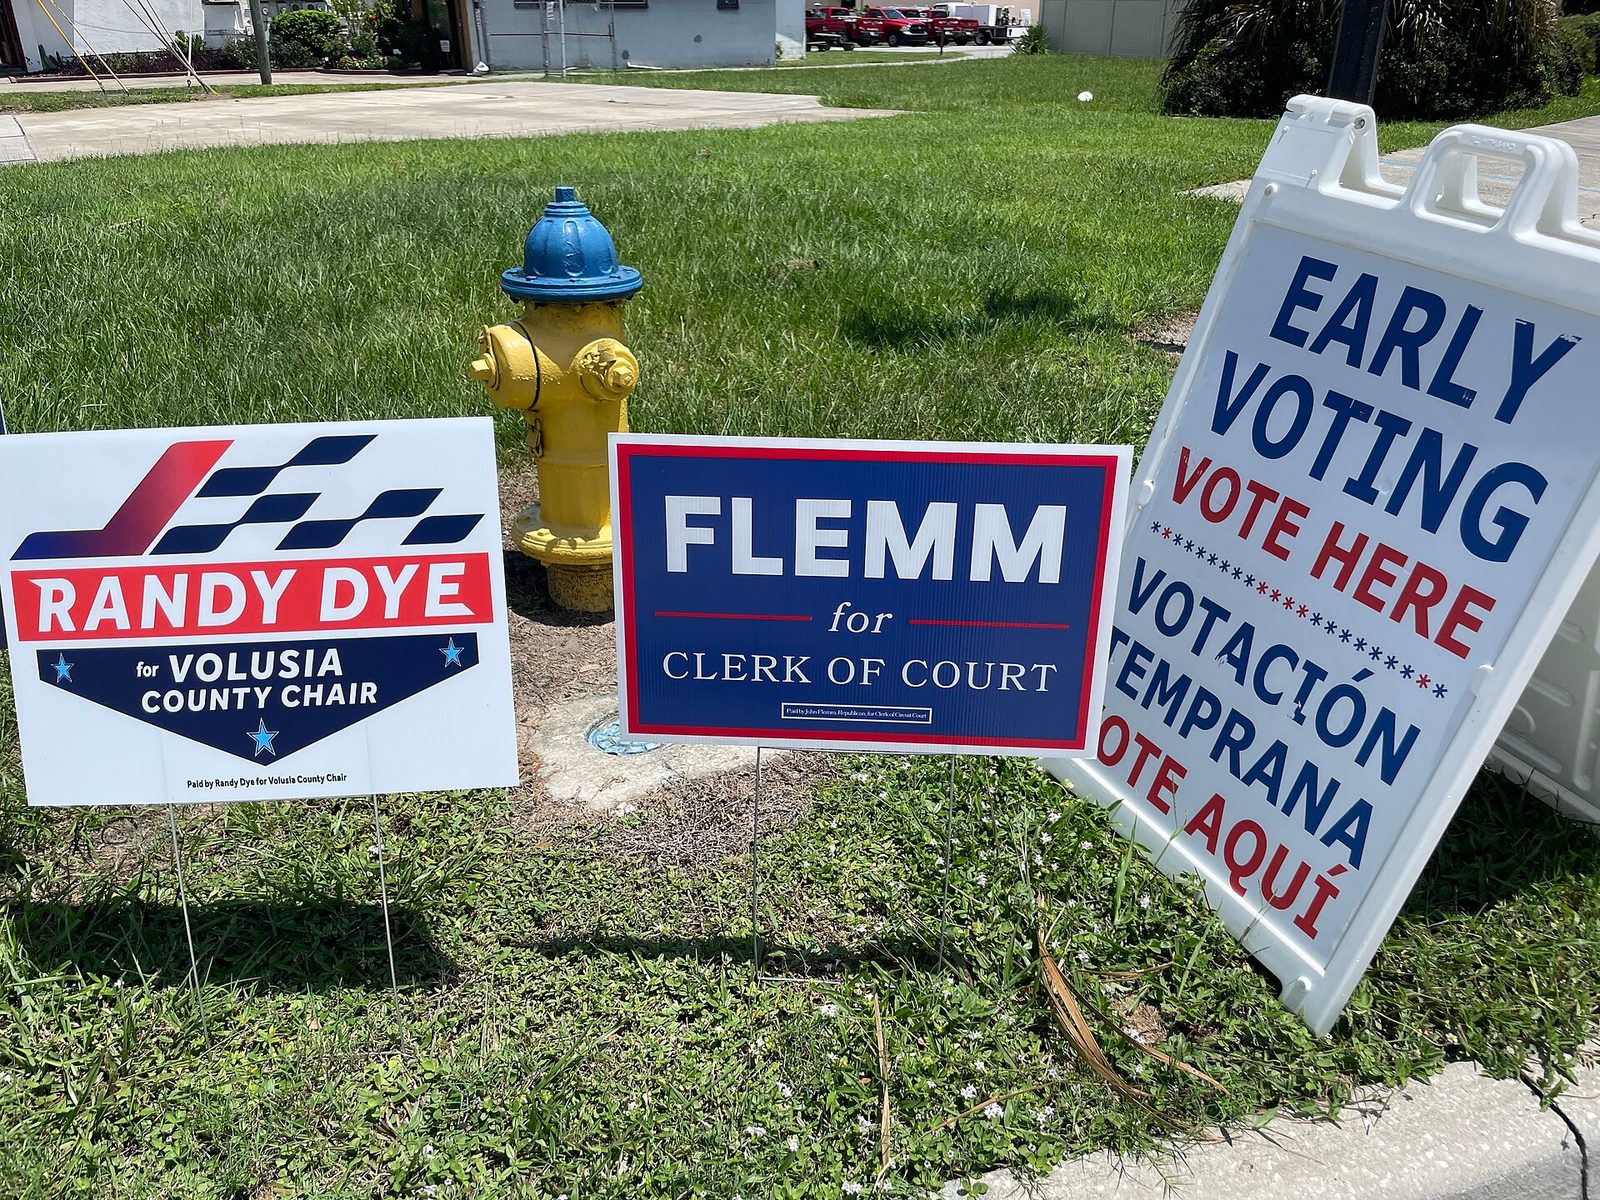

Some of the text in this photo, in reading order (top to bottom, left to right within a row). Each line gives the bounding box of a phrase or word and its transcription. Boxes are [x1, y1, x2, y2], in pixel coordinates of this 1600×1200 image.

[1269, 256, 1583, 425] EARLY
[1211, 350, 1549, 563] VOTING
[664, 495, 1067, 584] FLEMM
[1172, 446, 1497, 659] VOTE HERE
[29, 562, 476, 633] RANDY DYE
[828, 601, 893, 634] for
[136, 648, 343, 683] for VOLUSIA
[141, 682, 378, 714] COUNTY CHAIR
[662, 652, 1058, 692] CLERK OF COURT
[1127, 557, 1421, 787] VOTACIÓN
[786, 707, 800, 715] Paid
[804, 708, 818, 716] John
[912, 712, 927, 720] Court
[187, 773, 347, 789] Paid by Randy Dye for Volusia County Chair
[1097, 704, 1348, 939] OTE AQUÍ
